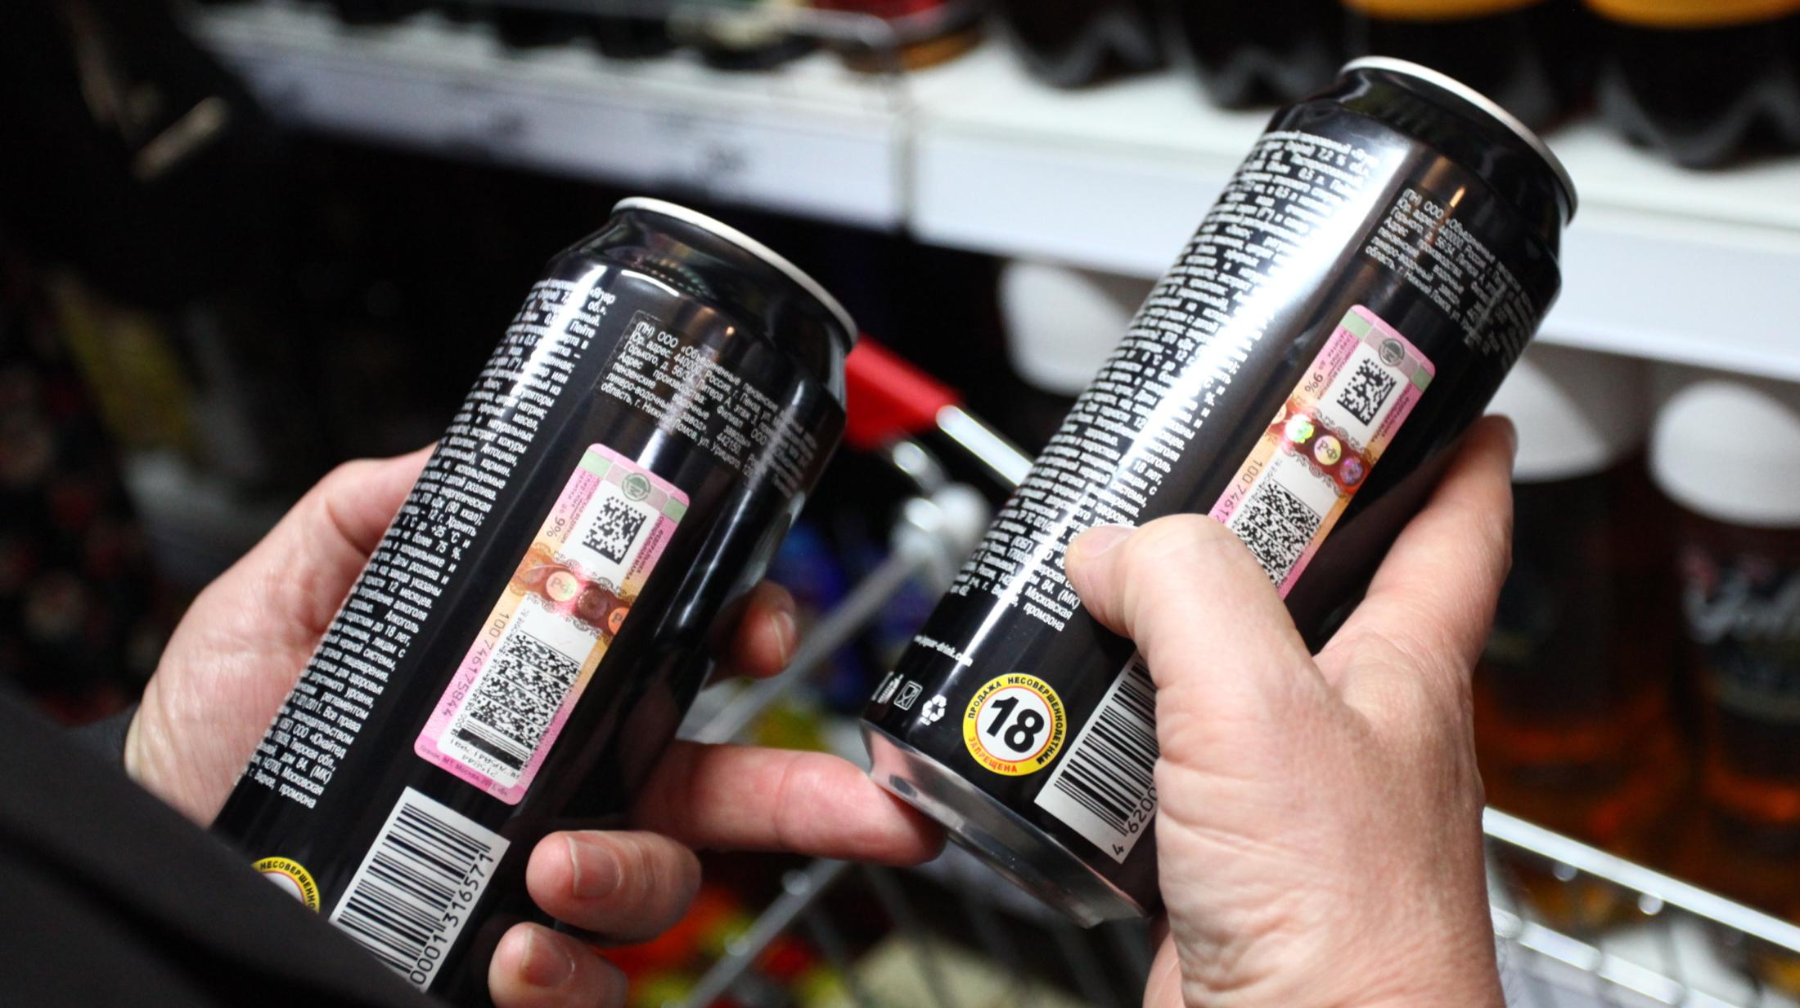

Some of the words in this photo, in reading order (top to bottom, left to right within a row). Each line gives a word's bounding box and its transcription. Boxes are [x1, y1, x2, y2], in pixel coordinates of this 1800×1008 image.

[1302, 370, 1325, 395] 9%
[1239, 457, 1264, 485] 100
[544, 514, 567, 541] 9%
[385, 625, 397, 637] 18
[487, 609, 511, 640] 100
[1023, 602, 1069, 632] промзона
[440, 635, 495, 721] 746175844
[968, 681, 1002, 719] ПРОДАЖА
[986, 696, 1044, 753] 18
[968, 737, 1018, 773] ЗАПРЕЩЕНА
[279, 783, 317, 809] промзона
[437, 849, 498, 928] 316571
